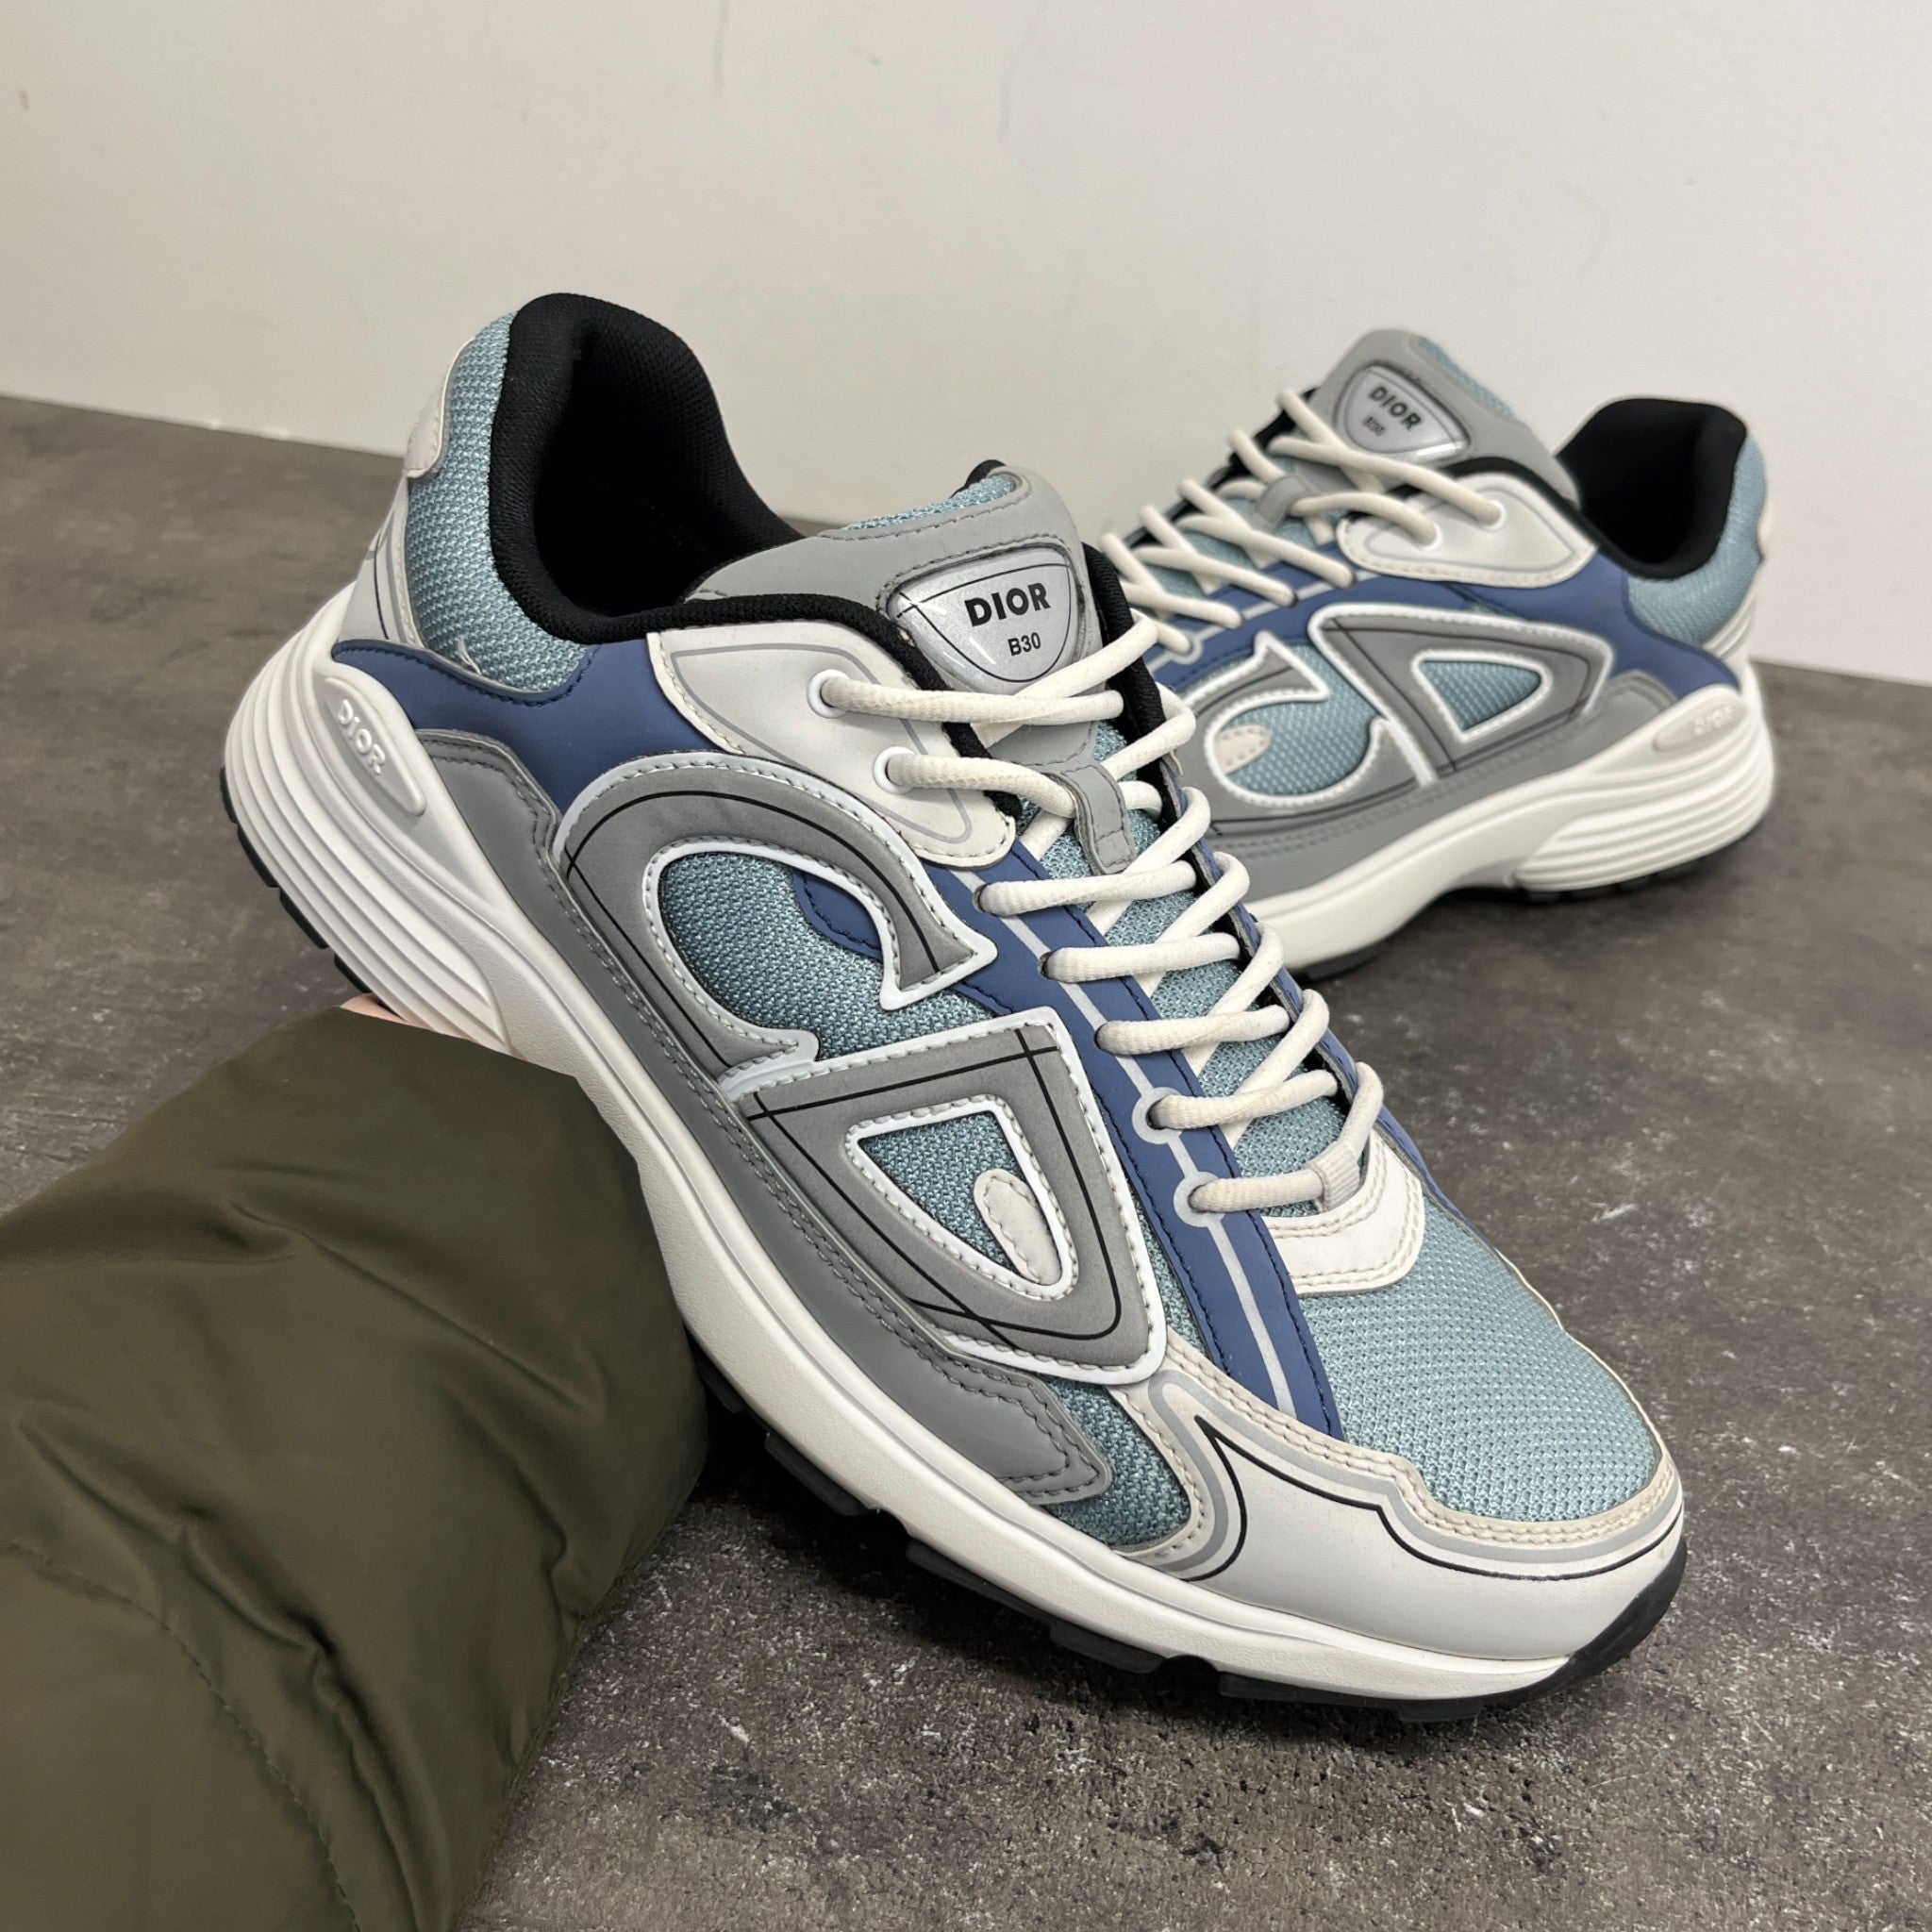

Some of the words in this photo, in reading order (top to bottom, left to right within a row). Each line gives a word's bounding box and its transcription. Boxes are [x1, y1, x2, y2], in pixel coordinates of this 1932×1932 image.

[1369, 386, 1422, 430] DIOR
[964, 582, 1051, 626] DIOR
[1008, 632, 1041, 657] B30
